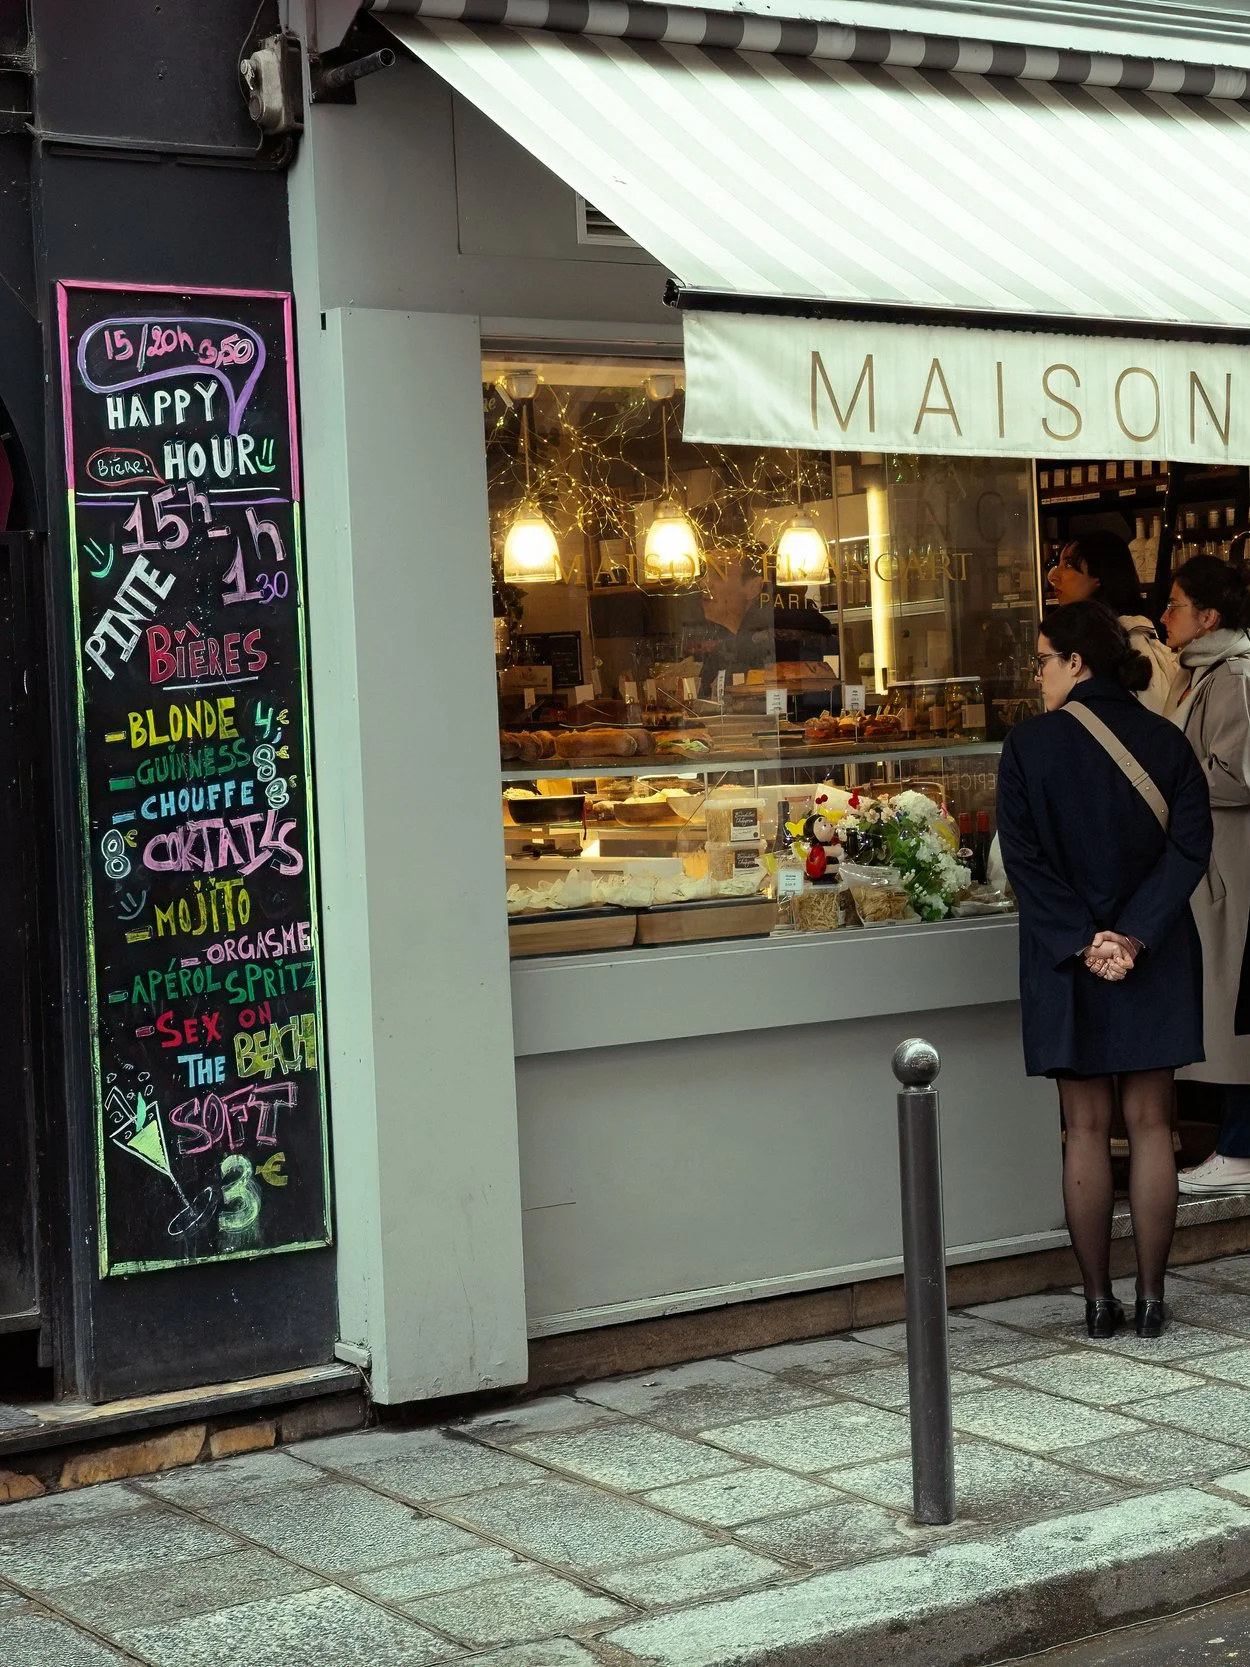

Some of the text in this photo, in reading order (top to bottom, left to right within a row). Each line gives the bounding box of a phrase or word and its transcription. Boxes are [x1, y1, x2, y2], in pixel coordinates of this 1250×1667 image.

[106, 380, 218, 430] HAPPY
[810, 350, 1232, 446] MAISON
[163, 433, 257, 480] HOUR
[553, 553, 728, 586] MAISON
[84, 553, 176, 681] PINTE
[760, 592, 822, 610] PARIS
[128, 697, 240, 748] BLONDE
[141, 780, 254, 820] CHOUFFE
[206, 921, 312, 964] ORGASME
[131, 958, 222, 1004] APÉROL
[156, 1001, 273, 1048] SEX ON
[177, 1013, 318, 1088] THE BEACH
[168, 1081, 298, 1155] SOFT
